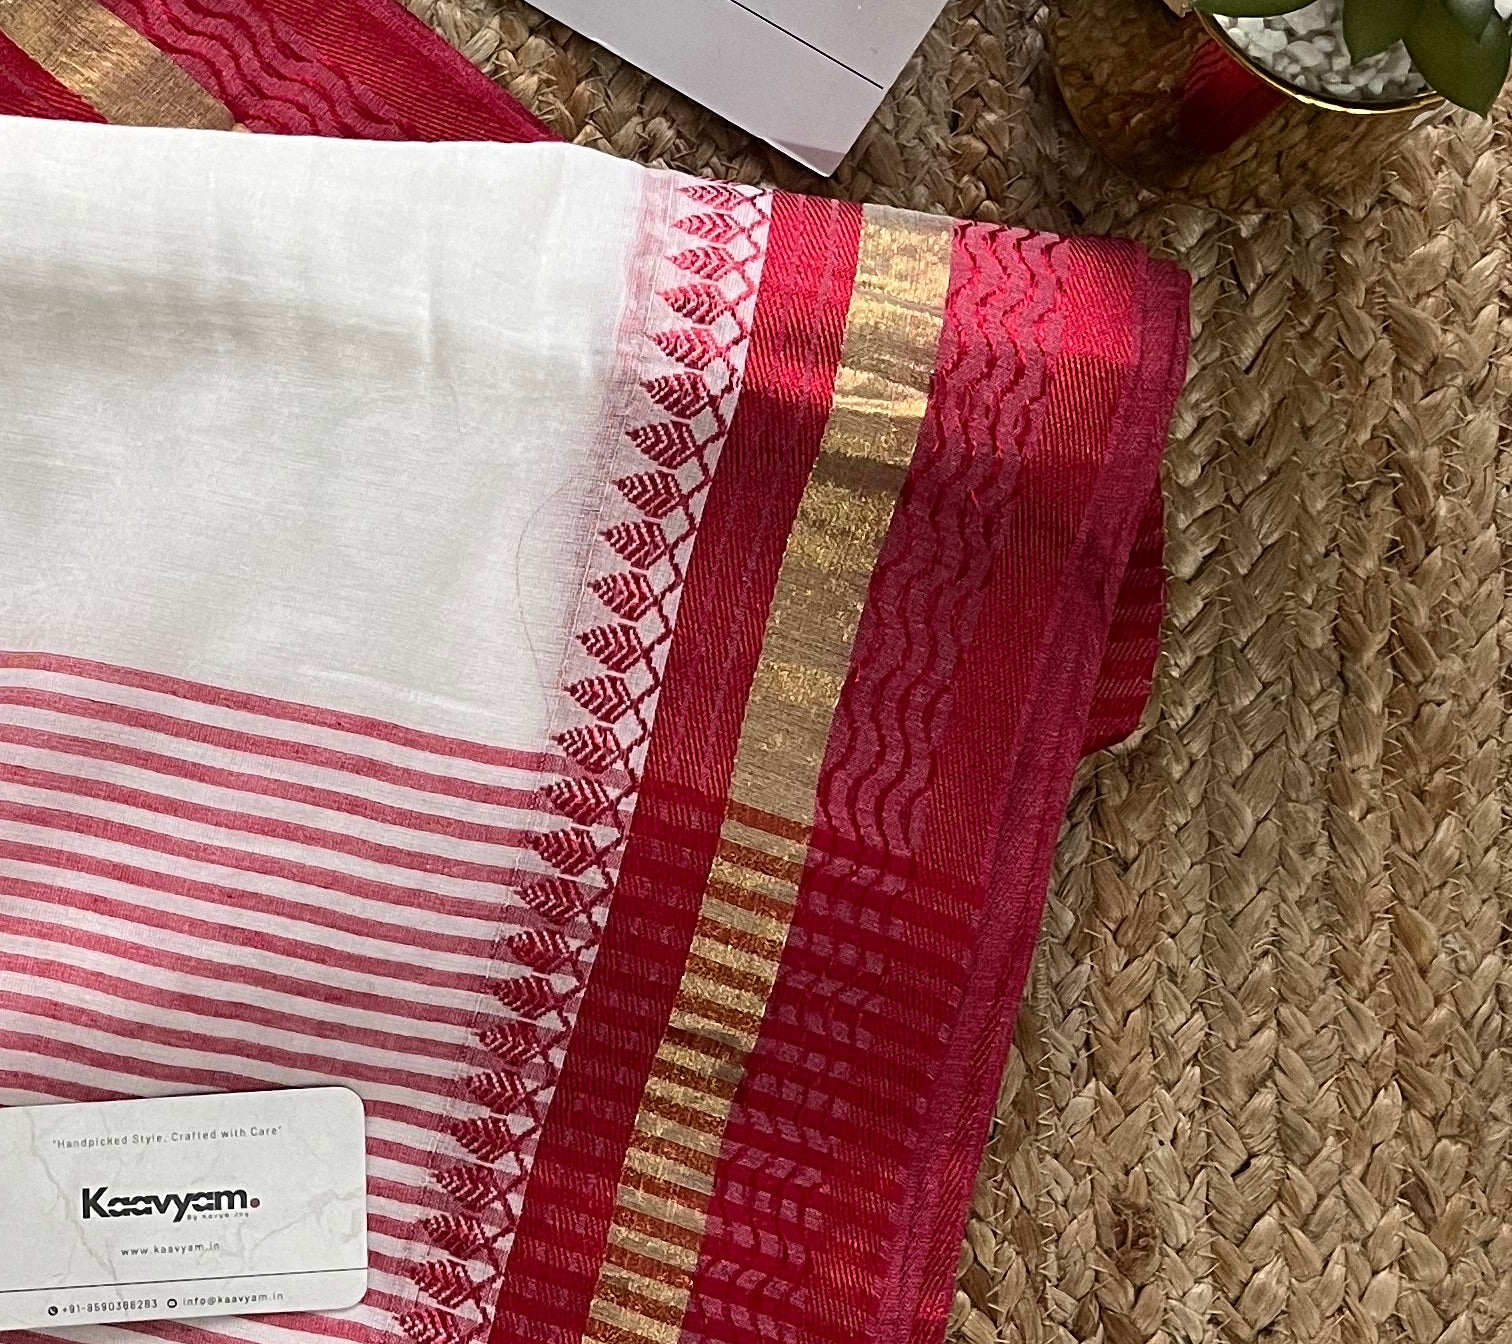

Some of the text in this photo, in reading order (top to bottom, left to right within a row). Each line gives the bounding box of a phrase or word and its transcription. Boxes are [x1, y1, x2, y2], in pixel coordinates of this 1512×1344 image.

[220, 1127, 247, 1139] with
[82, 1186, 261, 1223] Kaavyam.
[120, 1241, 221, 1257] www.kaavyam.in
[182, 1291, 284, 1306] info@kaavyam.in
